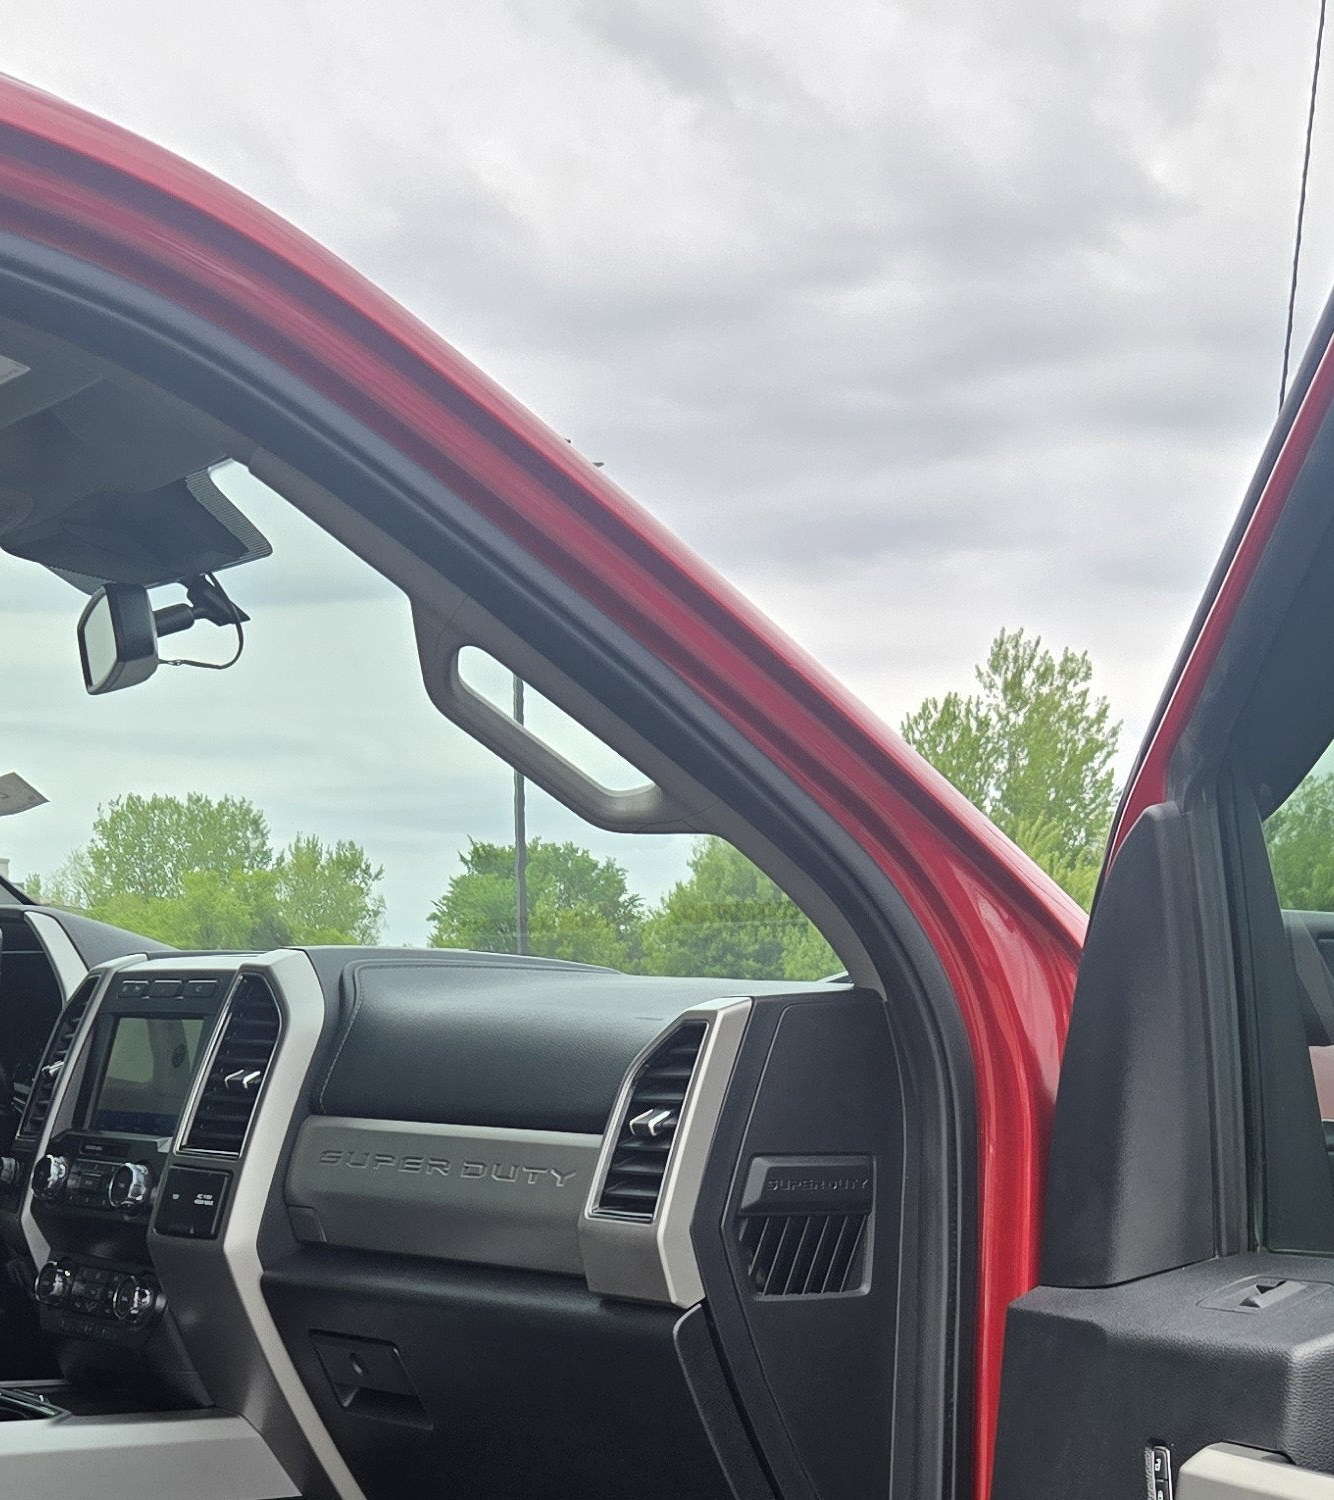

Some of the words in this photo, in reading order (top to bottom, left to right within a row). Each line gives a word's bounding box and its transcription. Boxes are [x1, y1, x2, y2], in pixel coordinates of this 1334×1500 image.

[318, 1149, 452, 1177] SUPER
[459, 1161, 577, 1188] DUTY
[766, 1180, 825, 1192] SUPER
